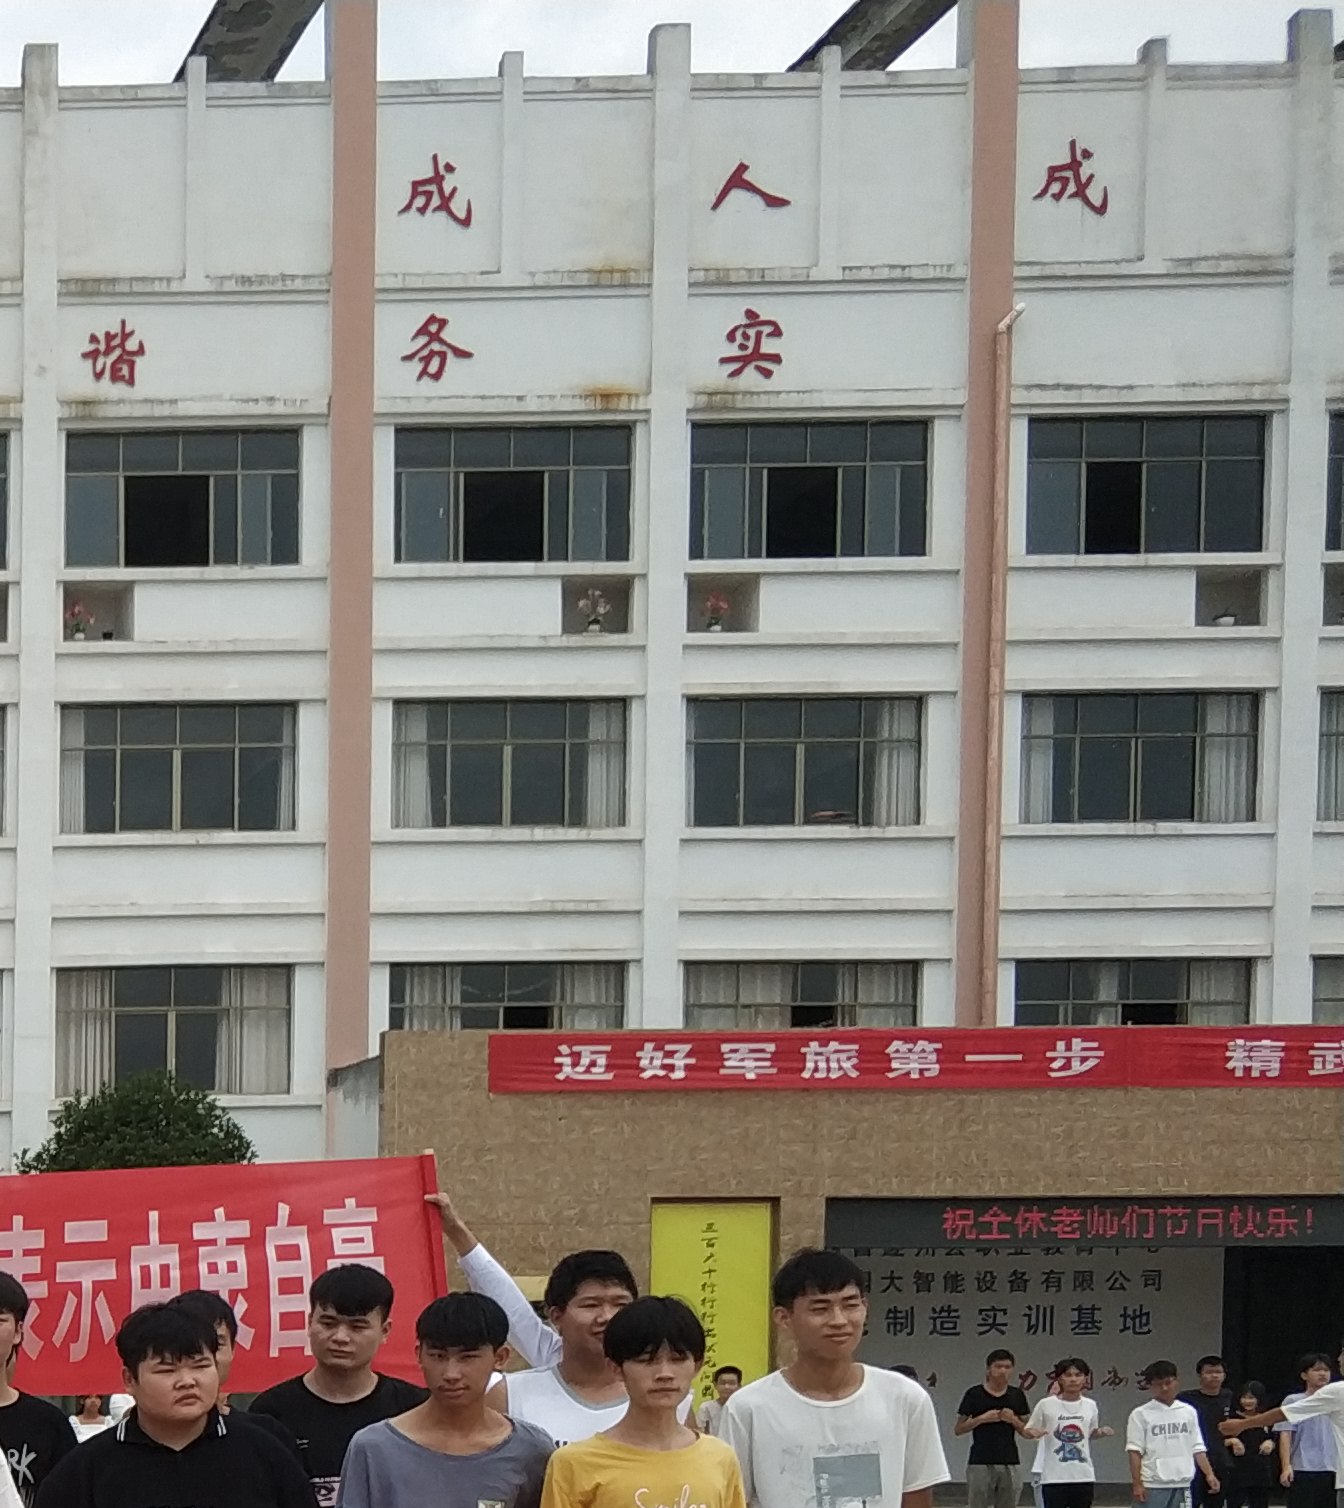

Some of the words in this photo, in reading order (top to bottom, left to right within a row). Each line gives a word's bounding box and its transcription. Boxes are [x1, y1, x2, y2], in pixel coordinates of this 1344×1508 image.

[553, 1038, 1106, 1081] 迈好军旅第一步
[862, 1304, 1152, 1337] 制造实训基地
[1151, 1422, 1189, 1437] CHINA
